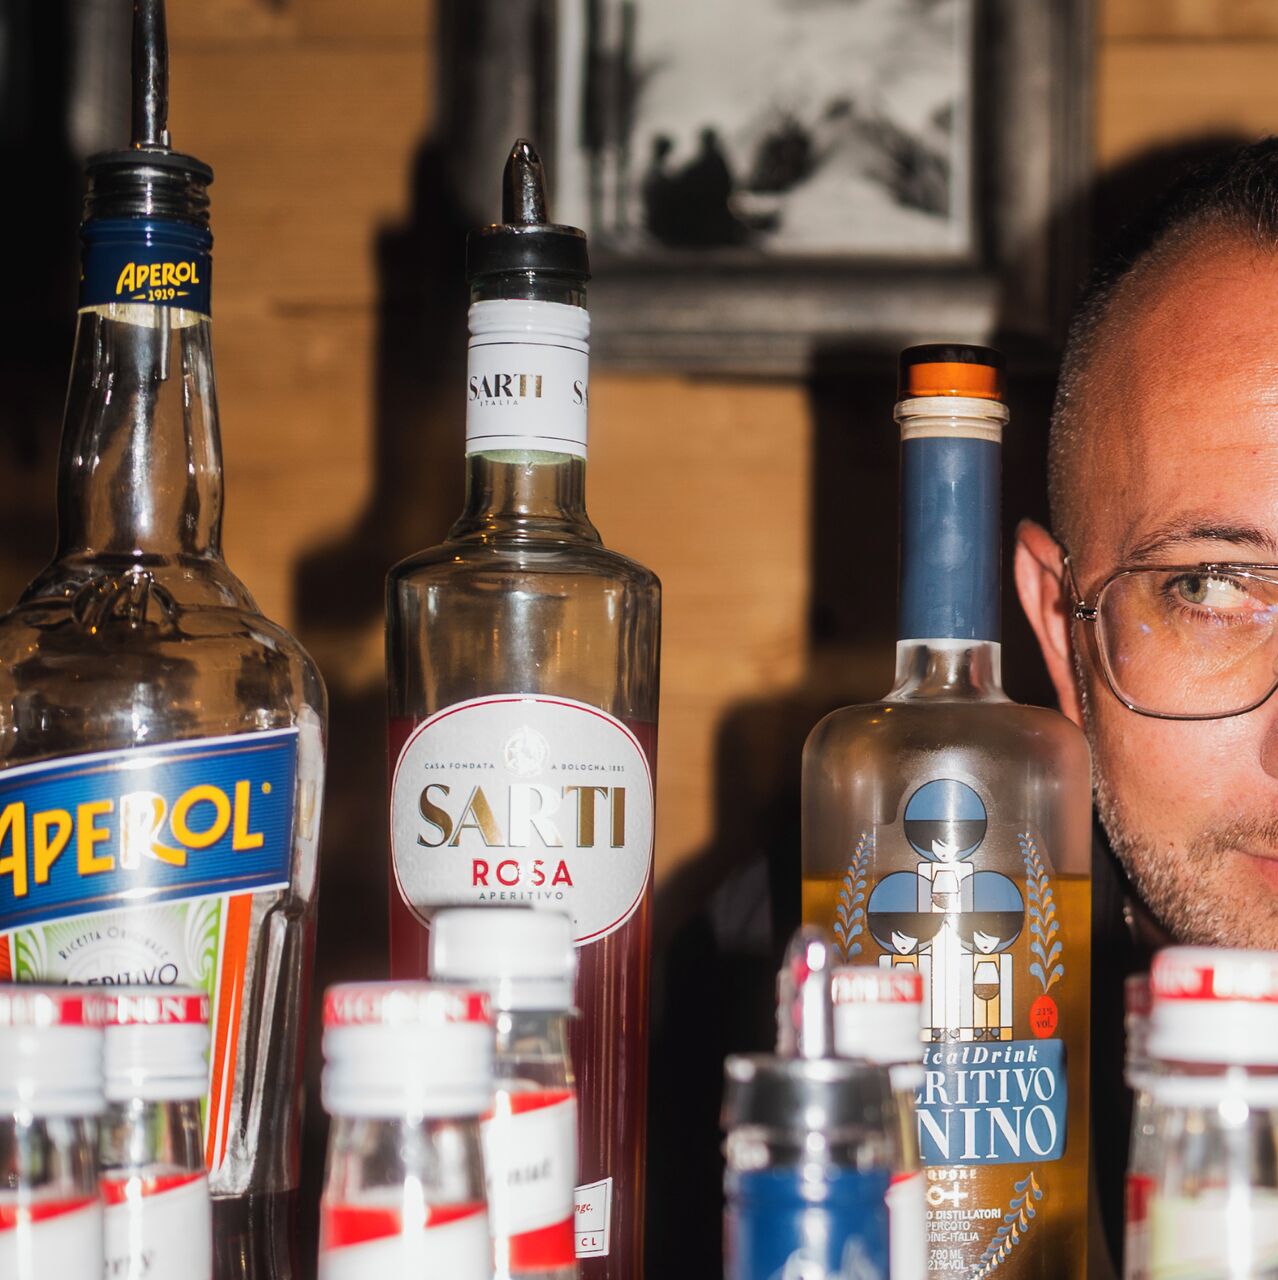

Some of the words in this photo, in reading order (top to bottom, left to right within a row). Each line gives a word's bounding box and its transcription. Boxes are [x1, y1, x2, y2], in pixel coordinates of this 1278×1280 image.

[115, 261, 200, 295] APEROL
[148, 288, 176, 302] 1919
[469, 373, 543, 402] SARTI
[480, 399, 519, 407] ITALIA
[424, 762, 446, 770] CASA
[416, 783, 626, 849] SARTI
[0, 780, 265, 898] APEROL
[472, 858, 574, 888] ROSA
[478, 891, 564, 901] APERITIVO
[935, 1207, 1002, 1220] DISTILLATORI
